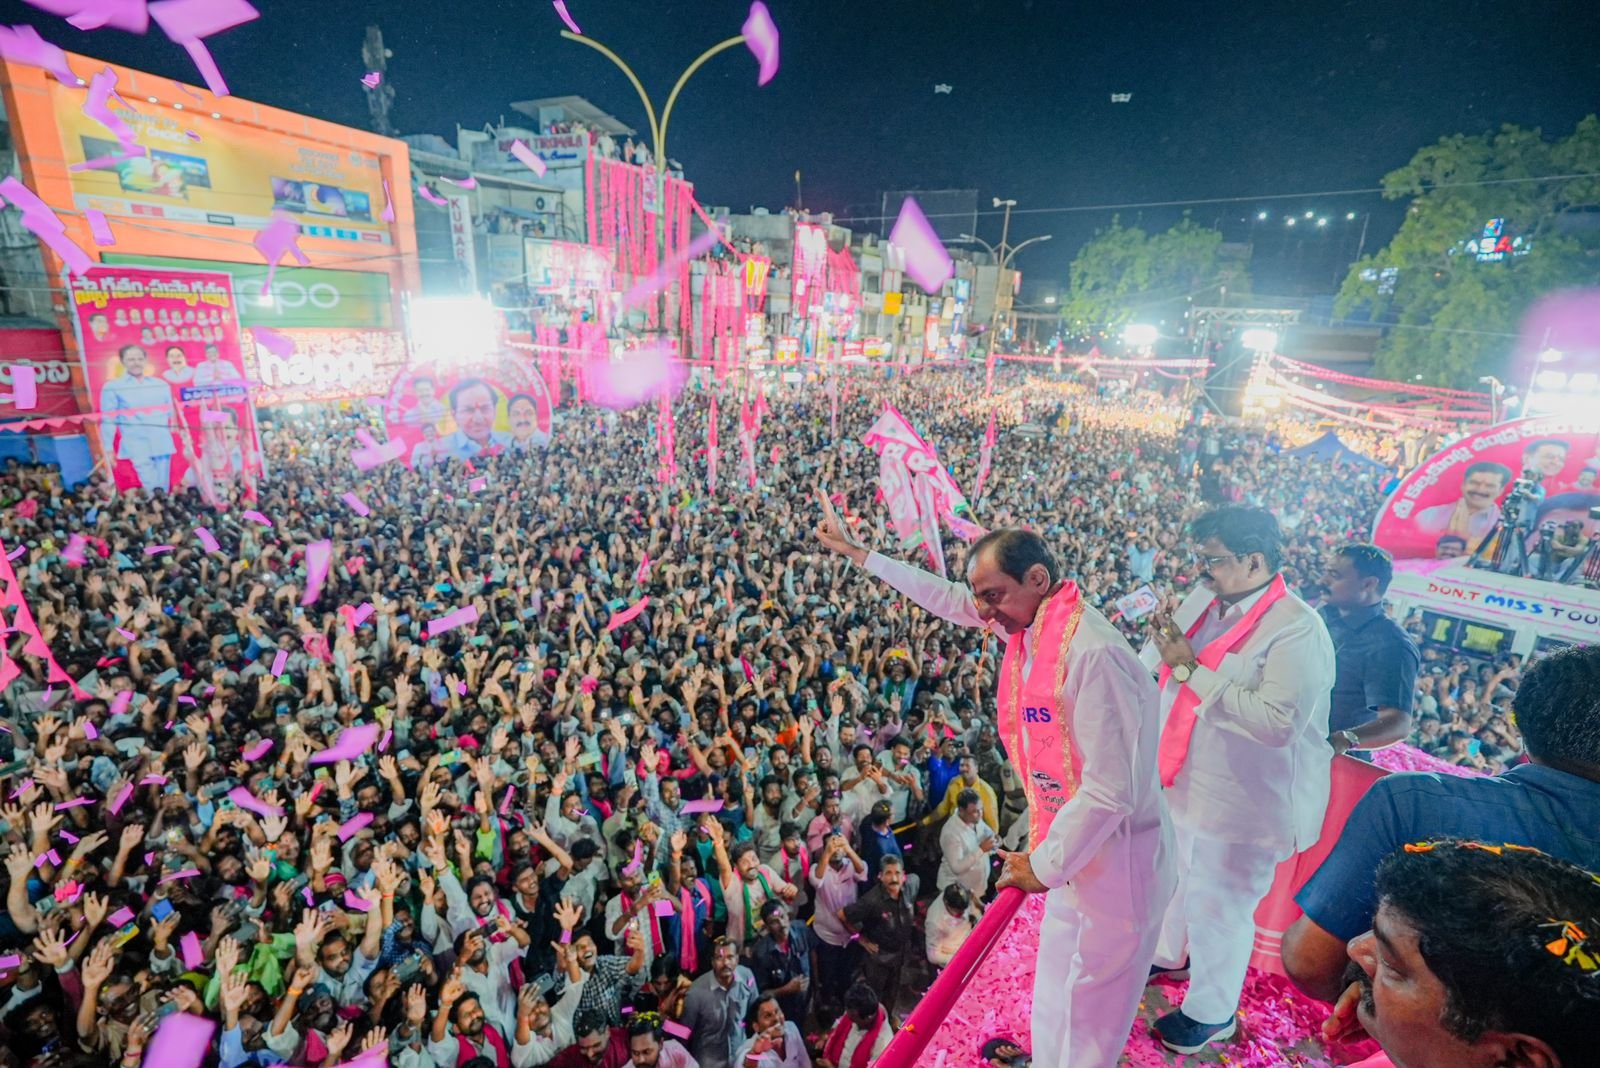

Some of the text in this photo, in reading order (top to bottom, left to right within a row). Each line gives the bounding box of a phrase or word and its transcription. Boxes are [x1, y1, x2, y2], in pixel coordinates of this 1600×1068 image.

[1484, 594, 1544, 614] MISS
[1551, 608, 1600, 625] TOU
[1022, 706, 1052, 723] RS
